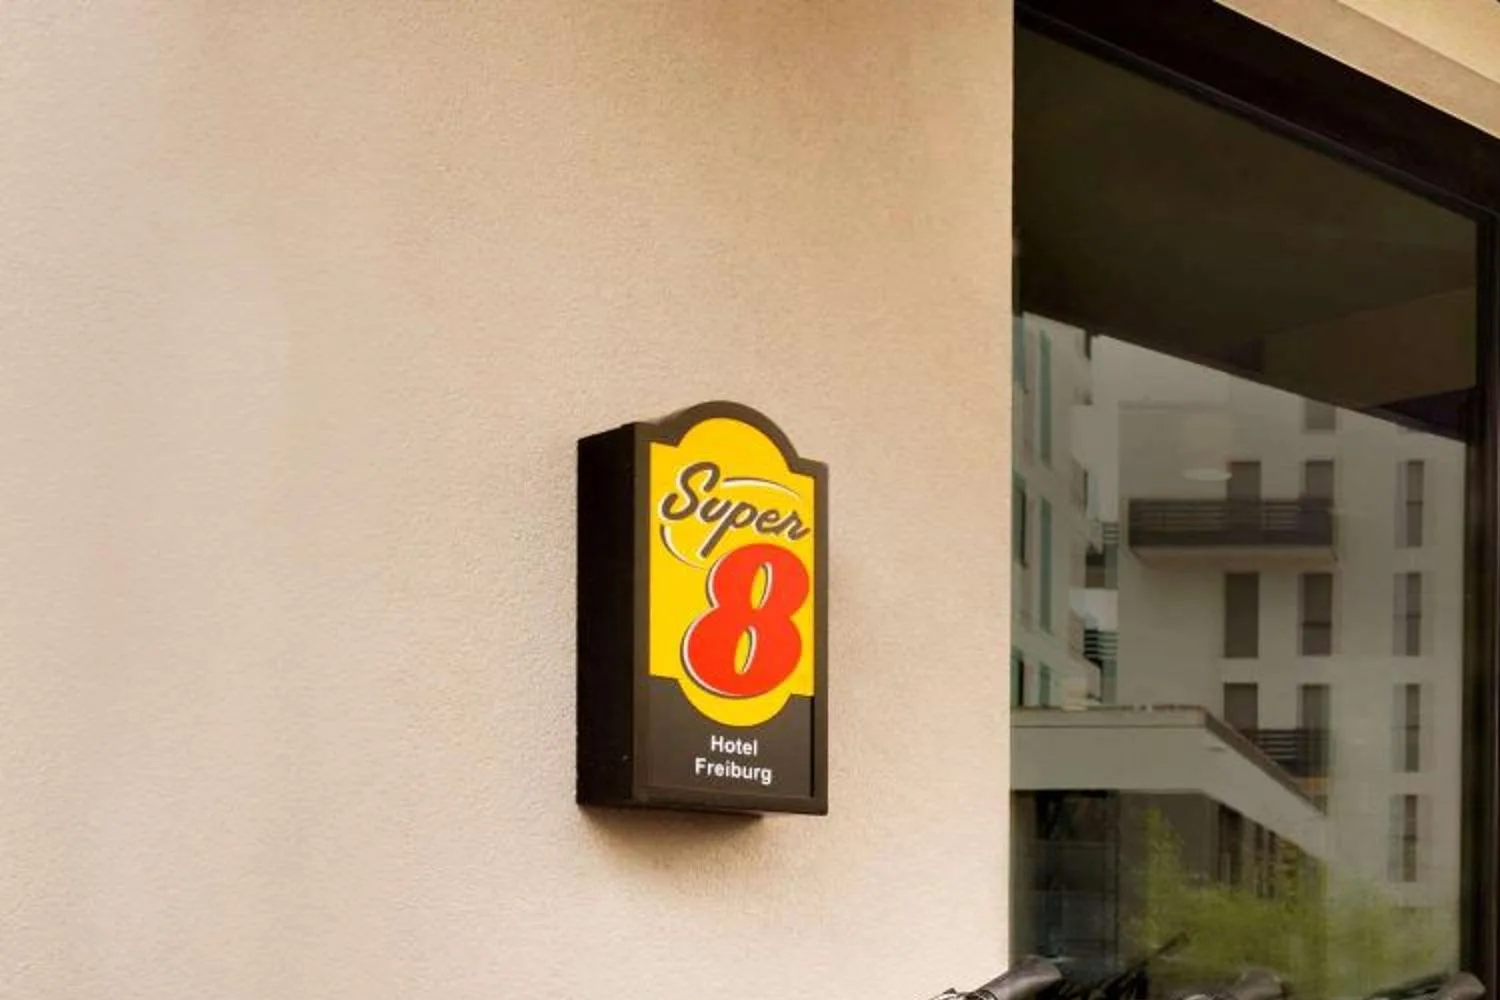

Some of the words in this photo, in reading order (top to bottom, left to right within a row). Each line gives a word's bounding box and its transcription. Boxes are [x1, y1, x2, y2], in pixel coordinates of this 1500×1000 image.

[660, 460, 811, 559] Super
[679, 542, 810, 700] 8
[694, 757, 773, 785] Freiburg
[710, 734, 759, 757] Hotel
